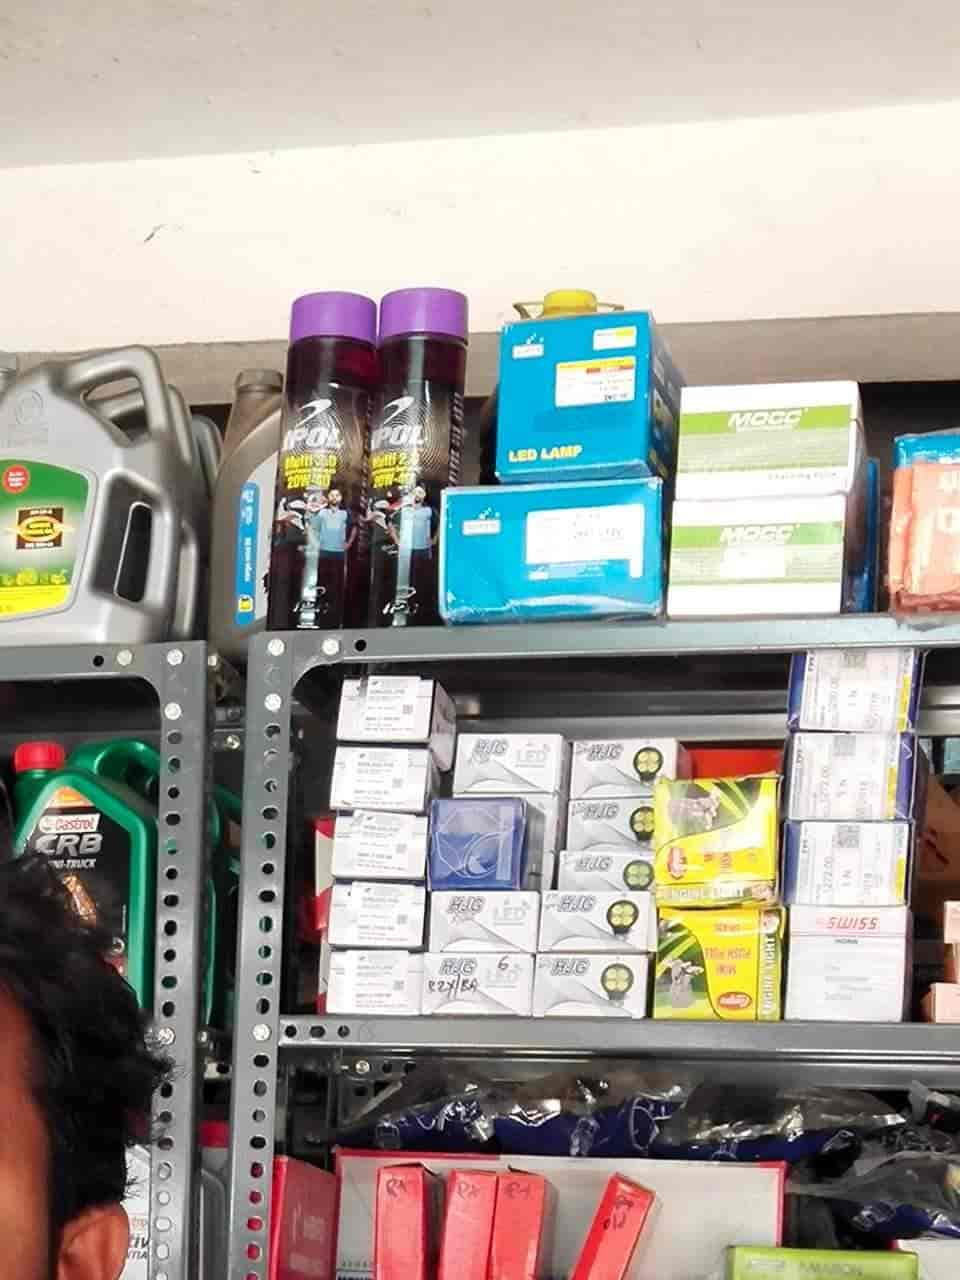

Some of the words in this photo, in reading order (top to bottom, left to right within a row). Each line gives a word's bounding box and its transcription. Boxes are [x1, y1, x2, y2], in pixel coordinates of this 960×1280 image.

[508, 448, 538, 463] LED
[541, 445, 584, 460] LAMP
[55, 818, 96, 831] Castrol
[35, 833, 103, 857] CRB
[826, 916, 879, 930] SWISS
[497, 956, 510, 971] 6
